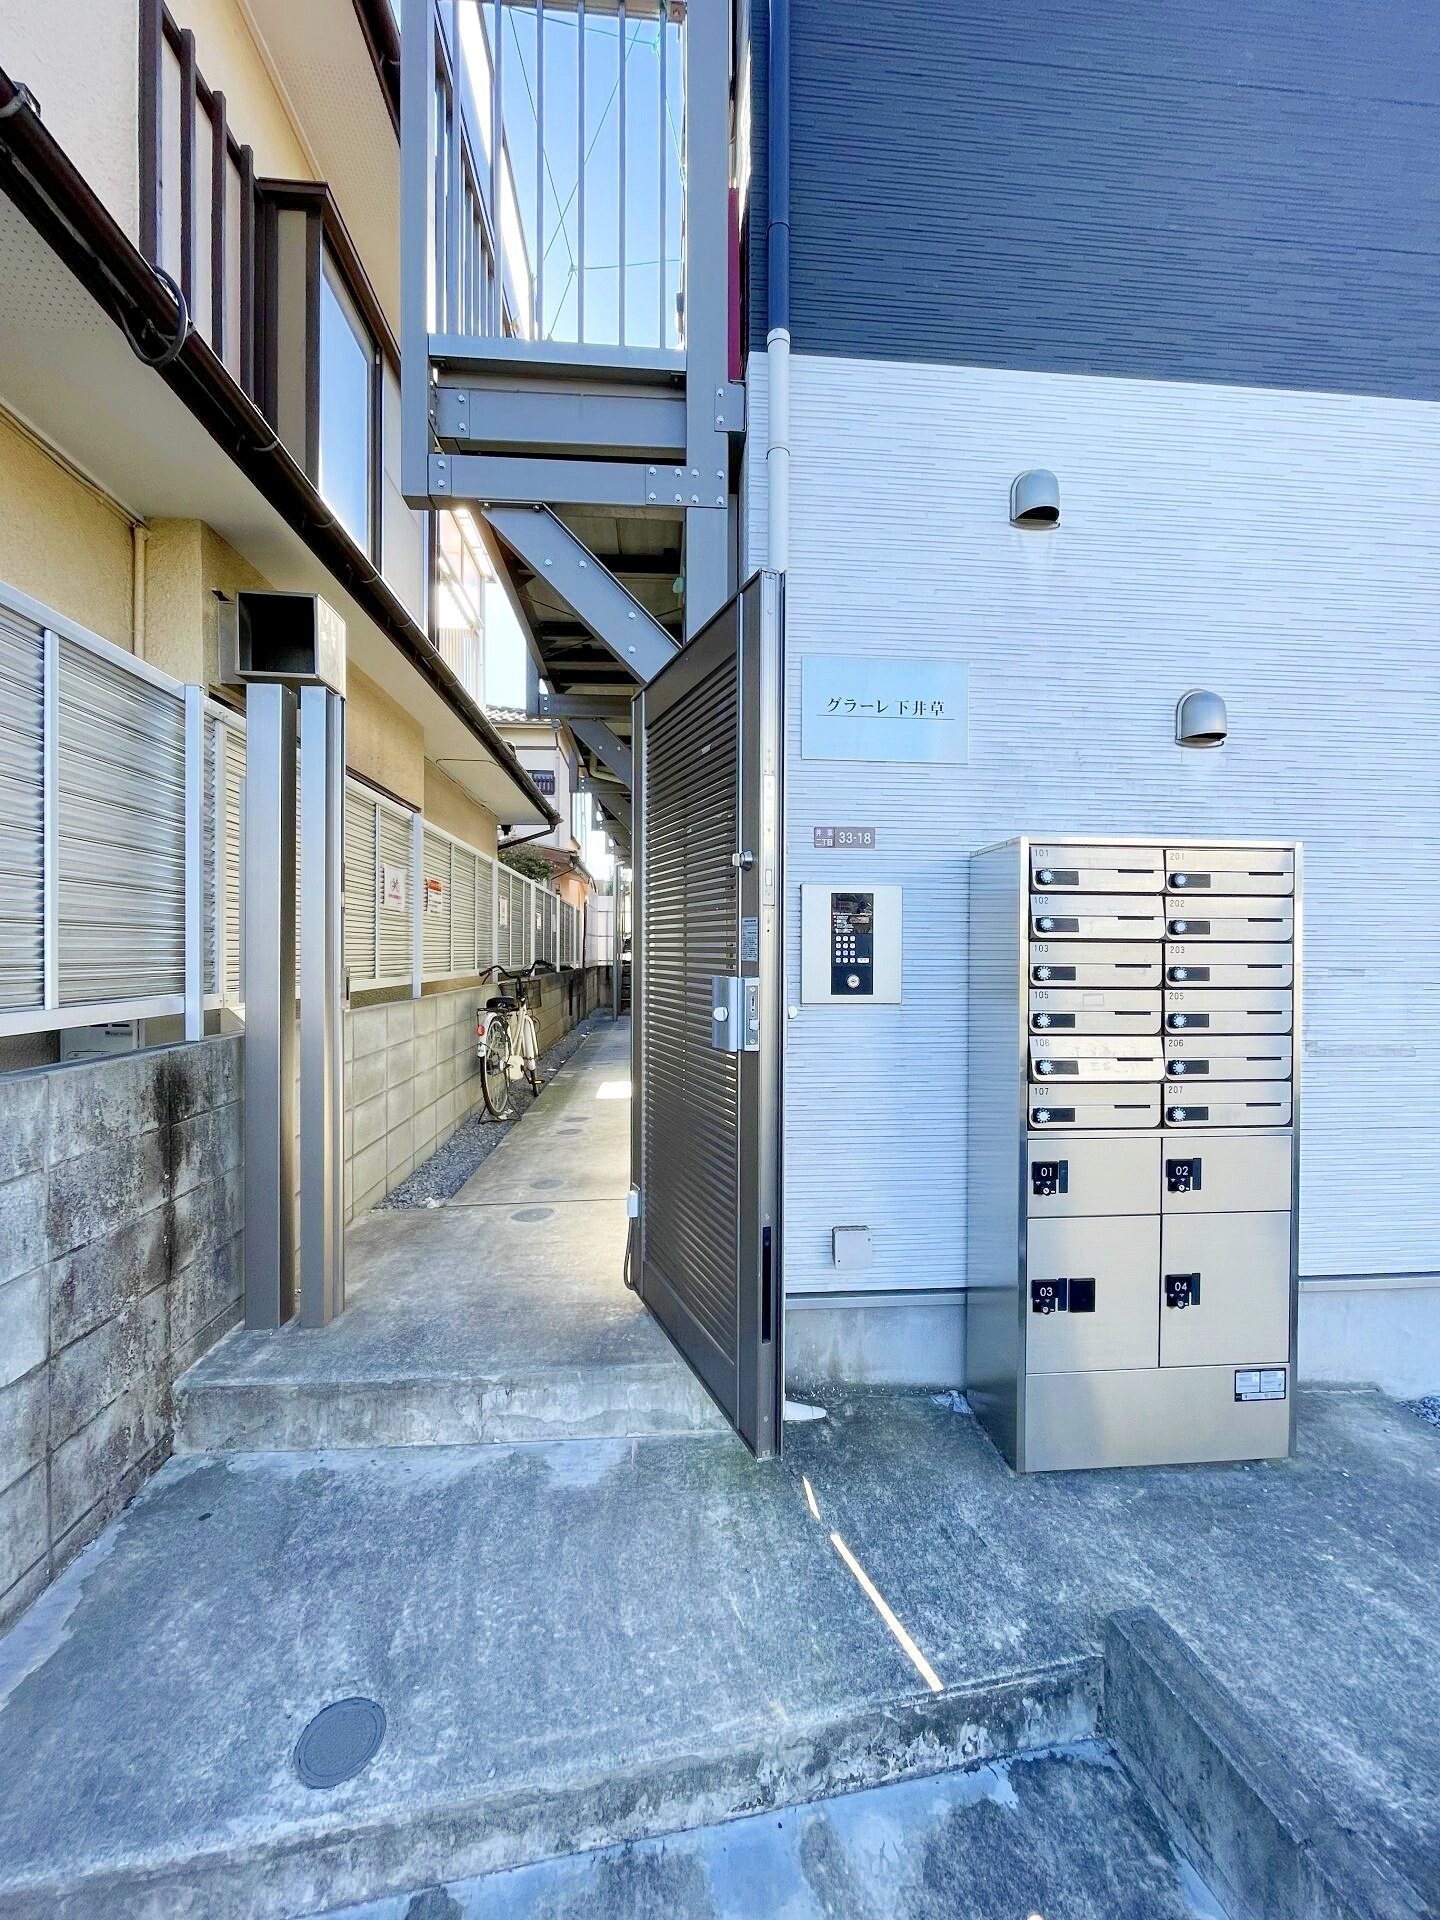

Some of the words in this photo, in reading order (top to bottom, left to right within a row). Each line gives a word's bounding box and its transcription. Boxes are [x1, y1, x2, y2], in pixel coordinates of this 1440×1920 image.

[839, 832, 871, 844] 33-18
[1034, 849, 1049, 857] 101
[1170, 852, 1185, 861] 201
[1034, 896, 1049, 905] 102
[1169, 900, 1185, 908] 202
[1034, 945, 1049, 953] 103
[1169, 946, 1185, 954] 203
[1034, 991, 1049, 999] 105
[1169, 992, 1184, 1000] 205
[1034, 1039, 1050, 1047] 106
[1168, 1039, 1184, 1047] 206
[1034, 1088, 1049, 1096] 107
[1168, 1086, 1184, 1094] 207
[1041, 1167, 1053, 1177] 01
[1175, 1166, 1189, 1176] 02
[1174, 1282, 1188, 1291] 04
[1039, 1287, 1053, 1297] 03
